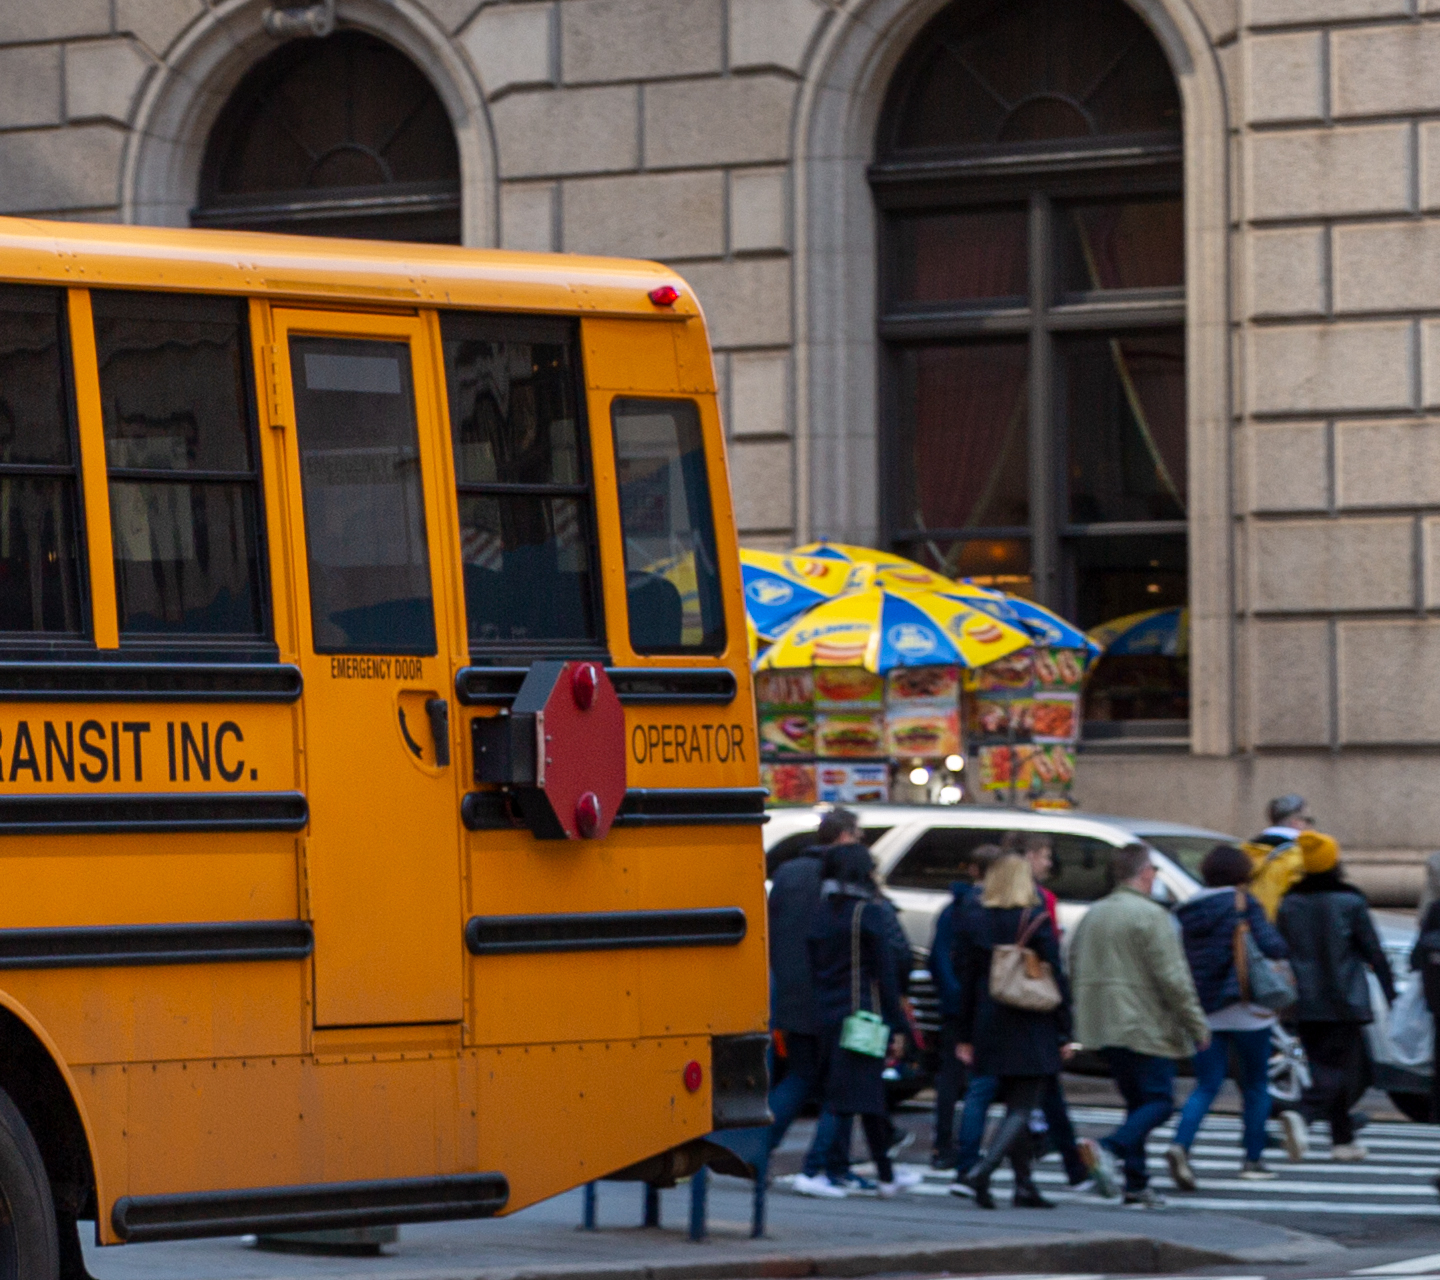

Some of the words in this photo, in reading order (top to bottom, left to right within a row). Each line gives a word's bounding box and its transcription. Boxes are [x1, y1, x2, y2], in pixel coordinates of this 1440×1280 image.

[330, 657, 391, 680] EMERGENCY
[394, 658, 423, 680] DOOR
[166, 720, 259, 783] INC.
[631, 723, 747, 764] OPERATOR
